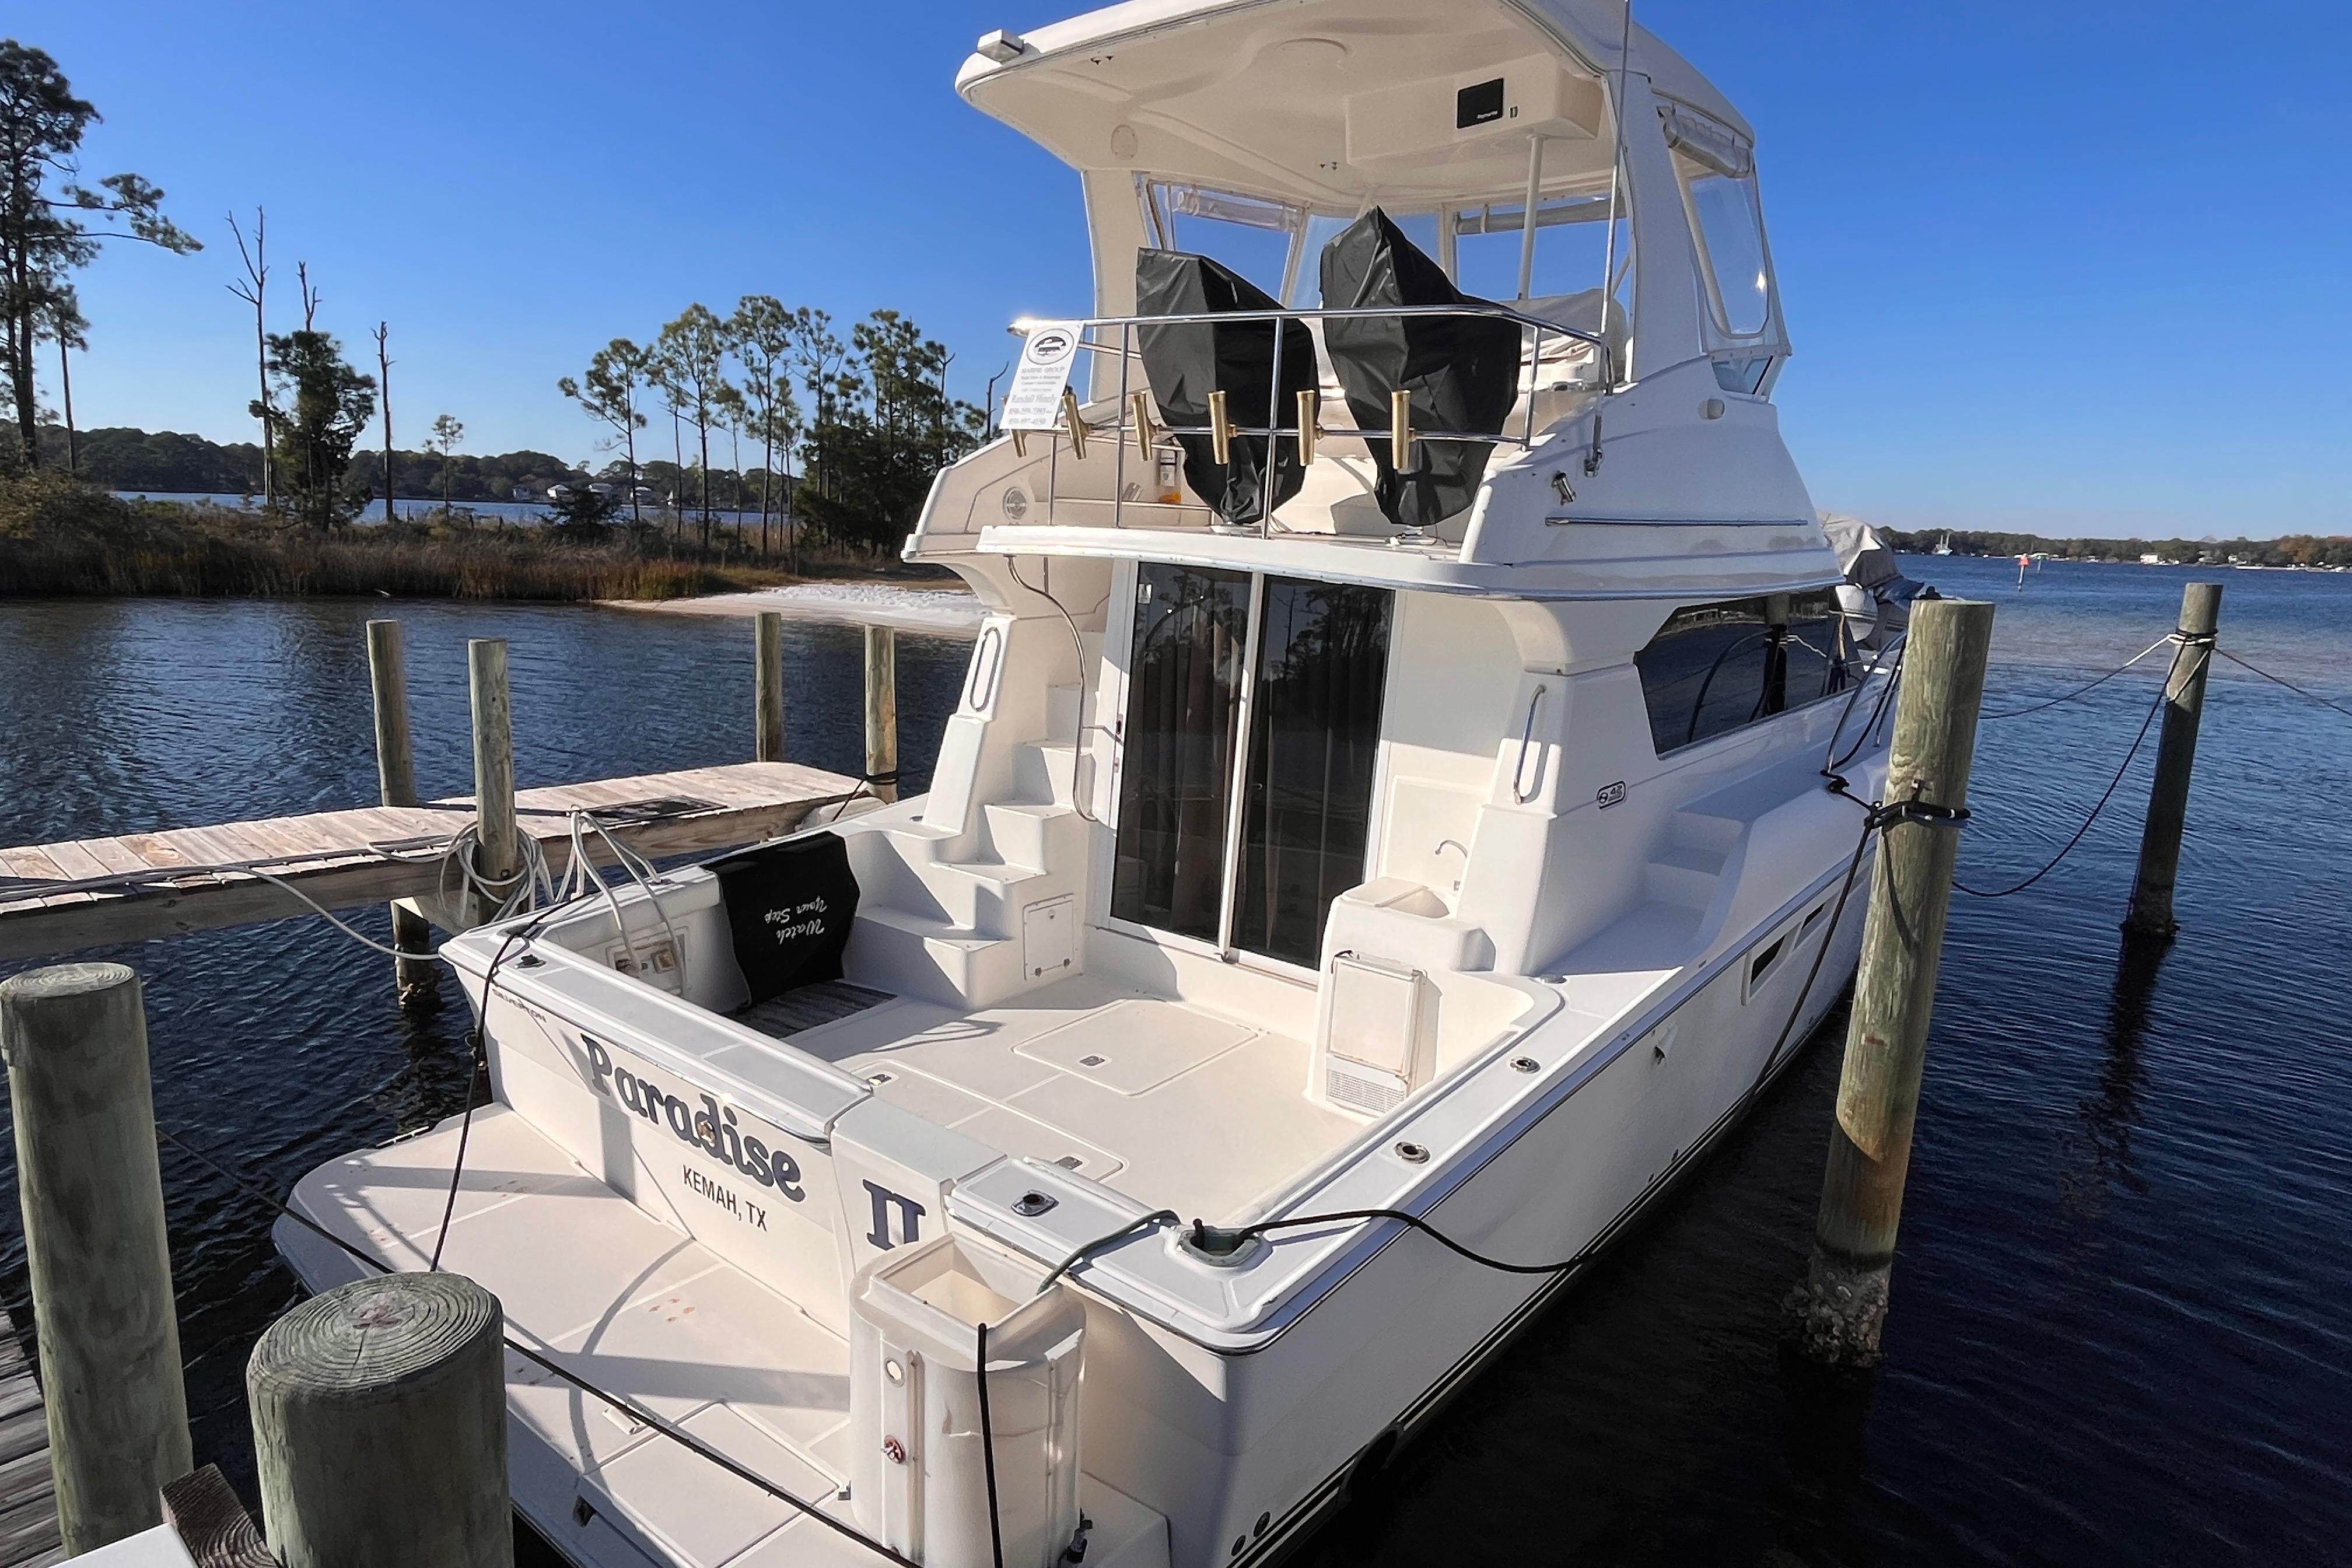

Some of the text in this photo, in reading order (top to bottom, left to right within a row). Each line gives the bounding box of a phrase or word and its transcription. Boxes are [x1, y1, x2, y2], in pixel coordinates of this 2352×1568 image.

[764, 908, 791, 924] Step
[776, 918, 825, 945] Watch
[580, 1032, 926, 1251] Paradise II
[682, 1164, 768, 1232] KEMAH, TX
